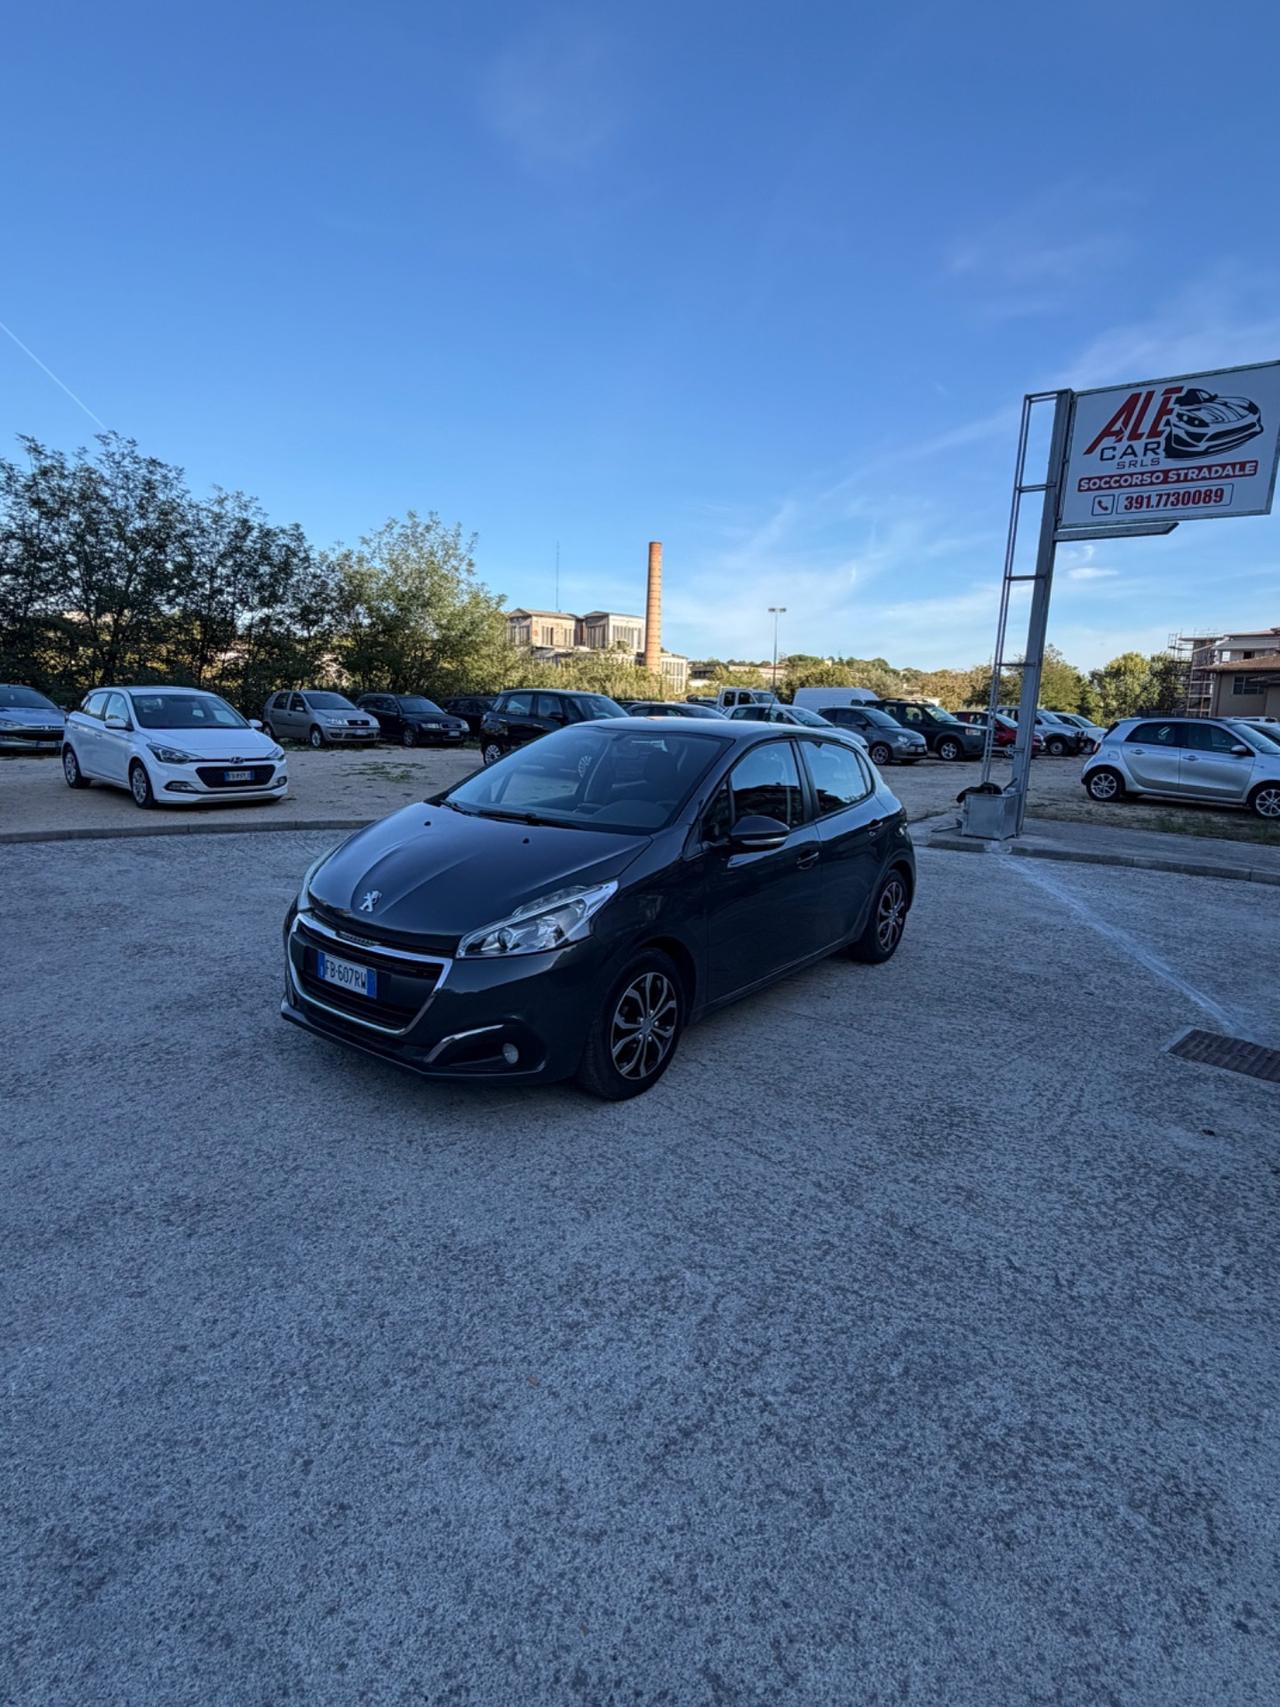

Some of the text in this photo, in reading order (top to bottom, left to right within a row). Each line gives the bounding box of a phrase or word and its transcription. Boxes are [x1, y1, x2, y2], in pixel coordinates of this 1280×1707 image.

[1083, 386, 1184, 455] ALE
[1100, 441, 1161, 461] CAR
[1116, 457, 1160, 469] SRLS
[1080, 462, 1256, 490] SOCCORSO STRADALE
[1124, 487, 1225, 511] 391.7730089
